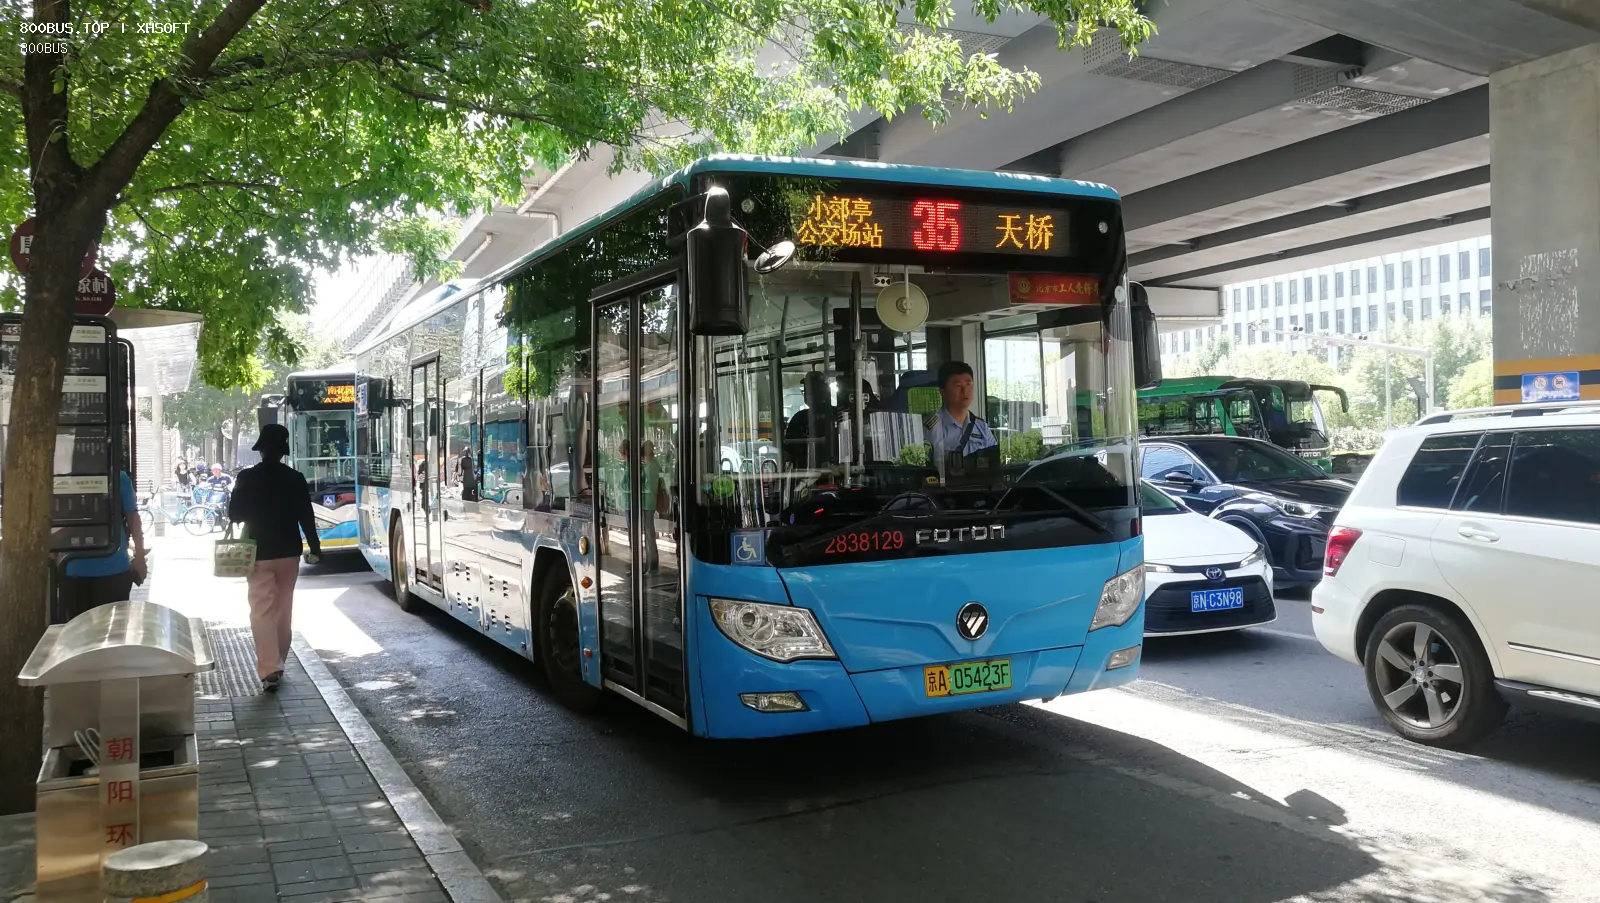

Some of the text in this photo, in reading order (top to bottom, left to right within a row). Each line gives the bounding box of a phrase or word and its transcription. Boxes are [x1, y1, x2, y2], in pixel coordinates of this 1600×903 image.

[807, 195, 873, 223] 小郊亭
[797, 219, 884, 249] 公交场站
[913, 200, 960, 251] 35
[995, 213, 1055, 250] 天桥
[77, 277, 108, 294] 家村
[825, 530, 904, 554] 2838129
[915, 524, 1006, 545] FOTON
